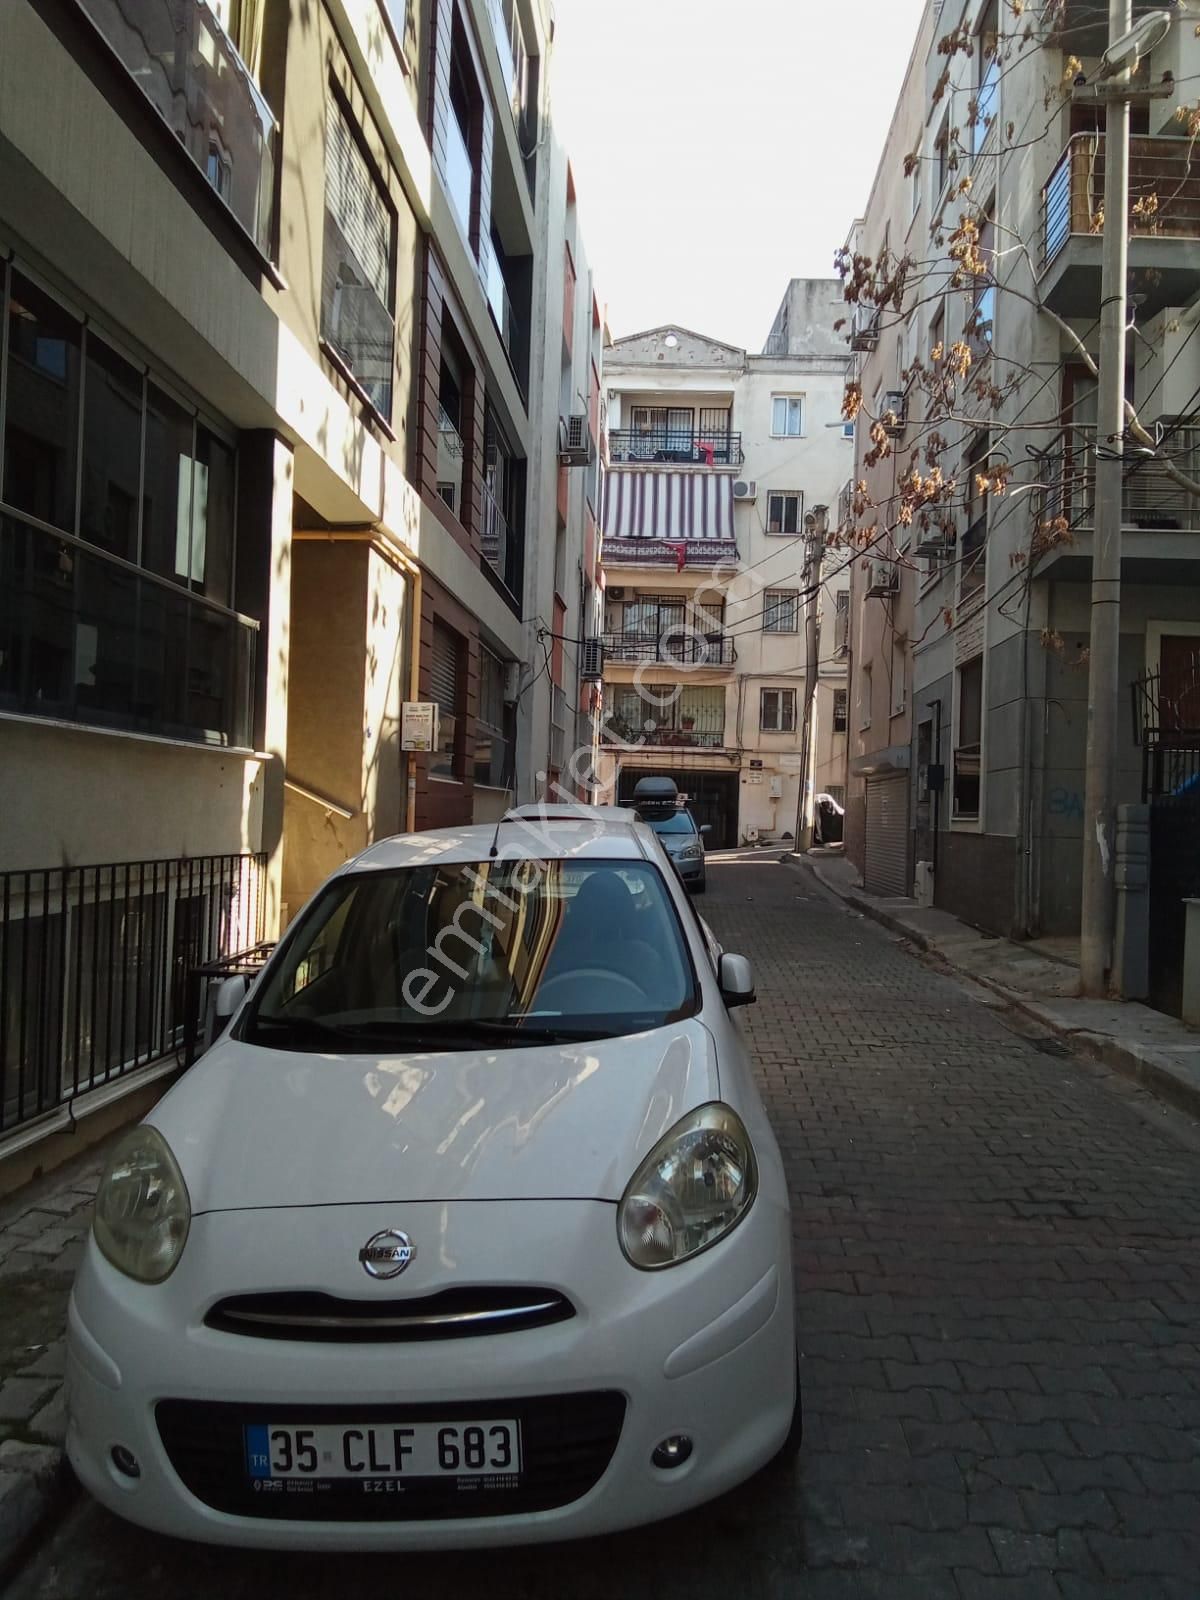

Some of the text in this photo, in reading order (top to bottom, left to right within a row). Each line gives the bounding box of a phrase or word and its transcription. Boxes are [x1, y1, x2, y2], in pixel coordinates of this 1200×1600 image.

[364, 1248, 410, 1259] NISSAN
[271, 1426, 512, 1473] 35 CLF 683
[251, 1453, 269, 1467] TR
[363, 1479, 406, 1493] EZEL
